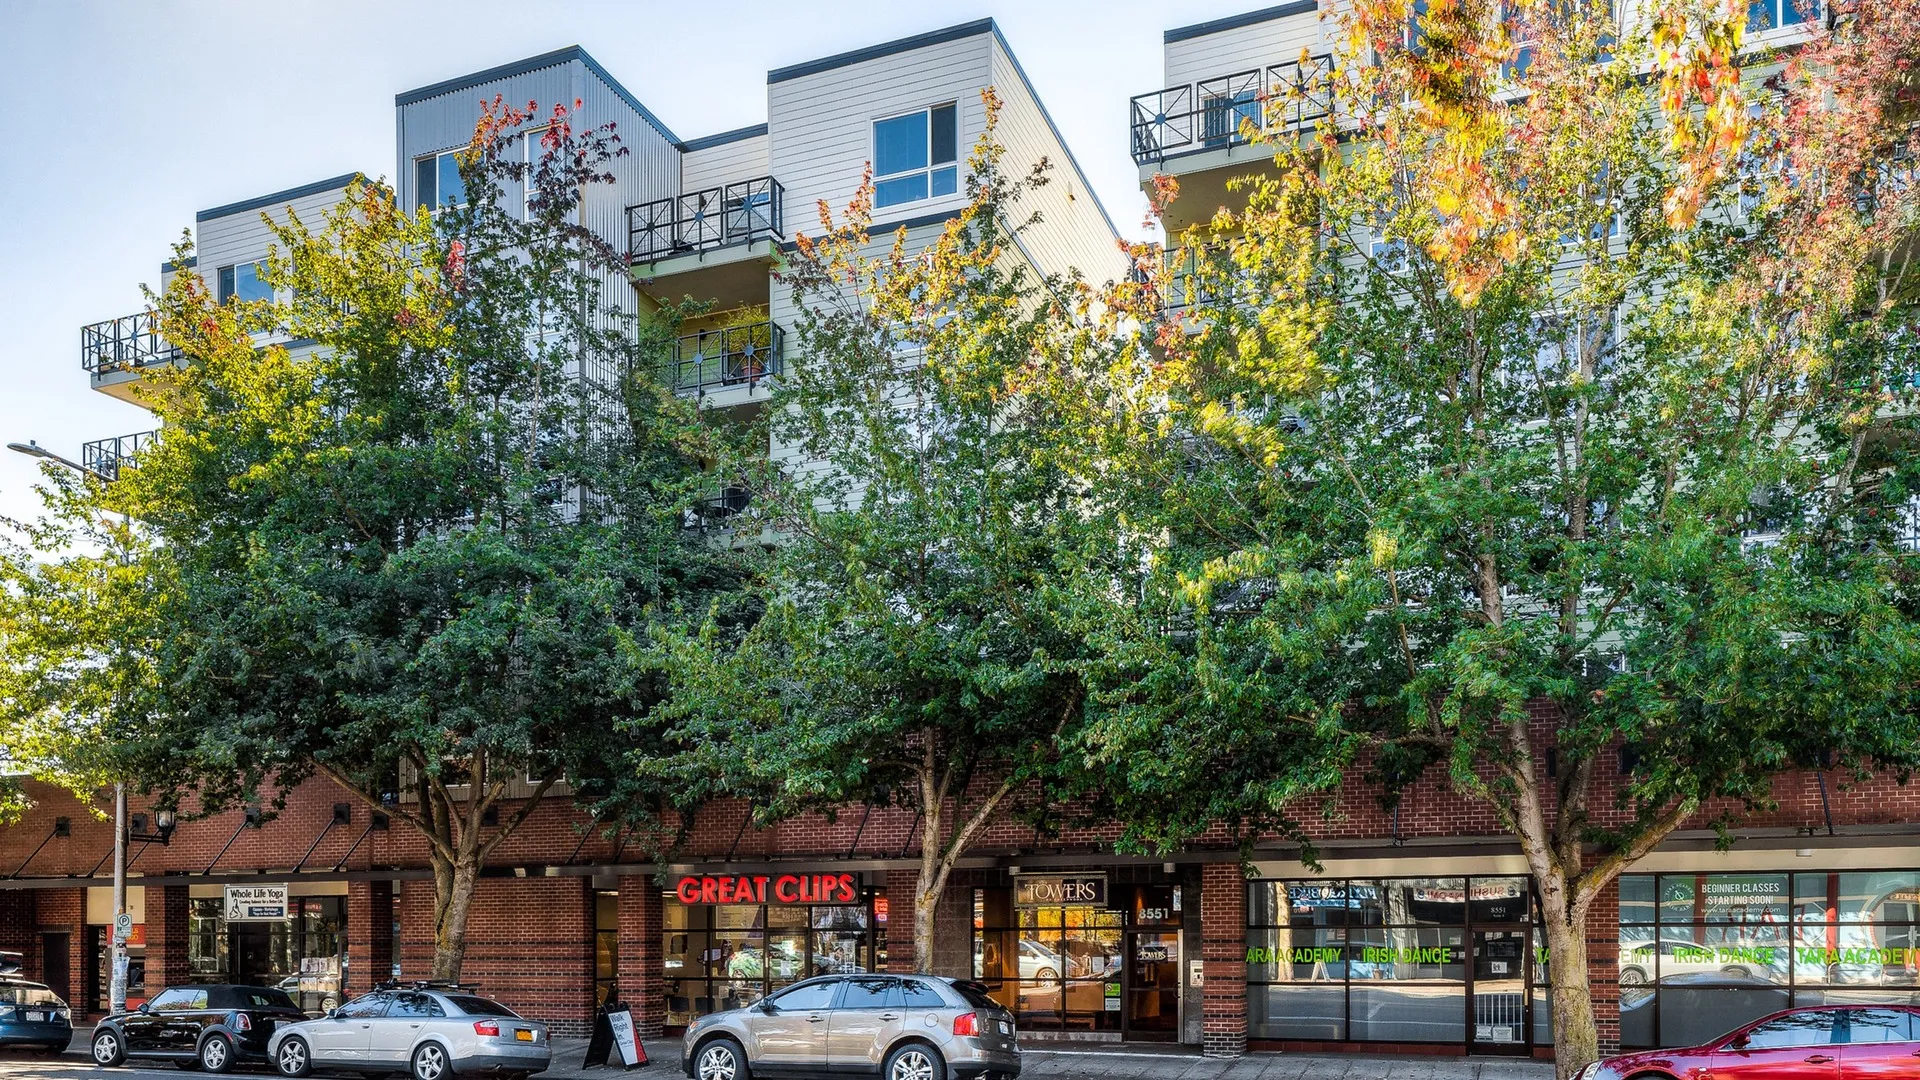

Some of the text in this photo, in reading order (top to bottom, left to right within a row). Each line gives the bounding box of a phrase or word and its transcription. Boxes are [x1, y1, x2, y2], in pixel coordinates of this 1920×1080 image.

[230, 888, 284, 899] Whole Life Yoga
[676, 876, 769, 904] GREAT
[1024, 882, 1096, 901] TOWERS
[1701, 882, 1780, 894] BEGINNER CLASSES
[1707, 895, 1774, 905] STARTING SOON!
[1138, 908, 1169, 920] 8551
[1490, 906, 1506, 914] 8551
[1700, 906, 1781, 914] www.taraacademy.com
[1140, 951, 1166, 961] TOWERS
[1245, 948, 1451, 963] ARA ACADEMY IRISH DANCE
[1673, 947, 1715, 964] IRISH
[1719, 947, 1775, 964] DANCE
[1796, 947, 1920, 965] TARA ACADEM
[610, 1013, 625, 1023] Walk
[613, 1022, 629, 1032] Right
